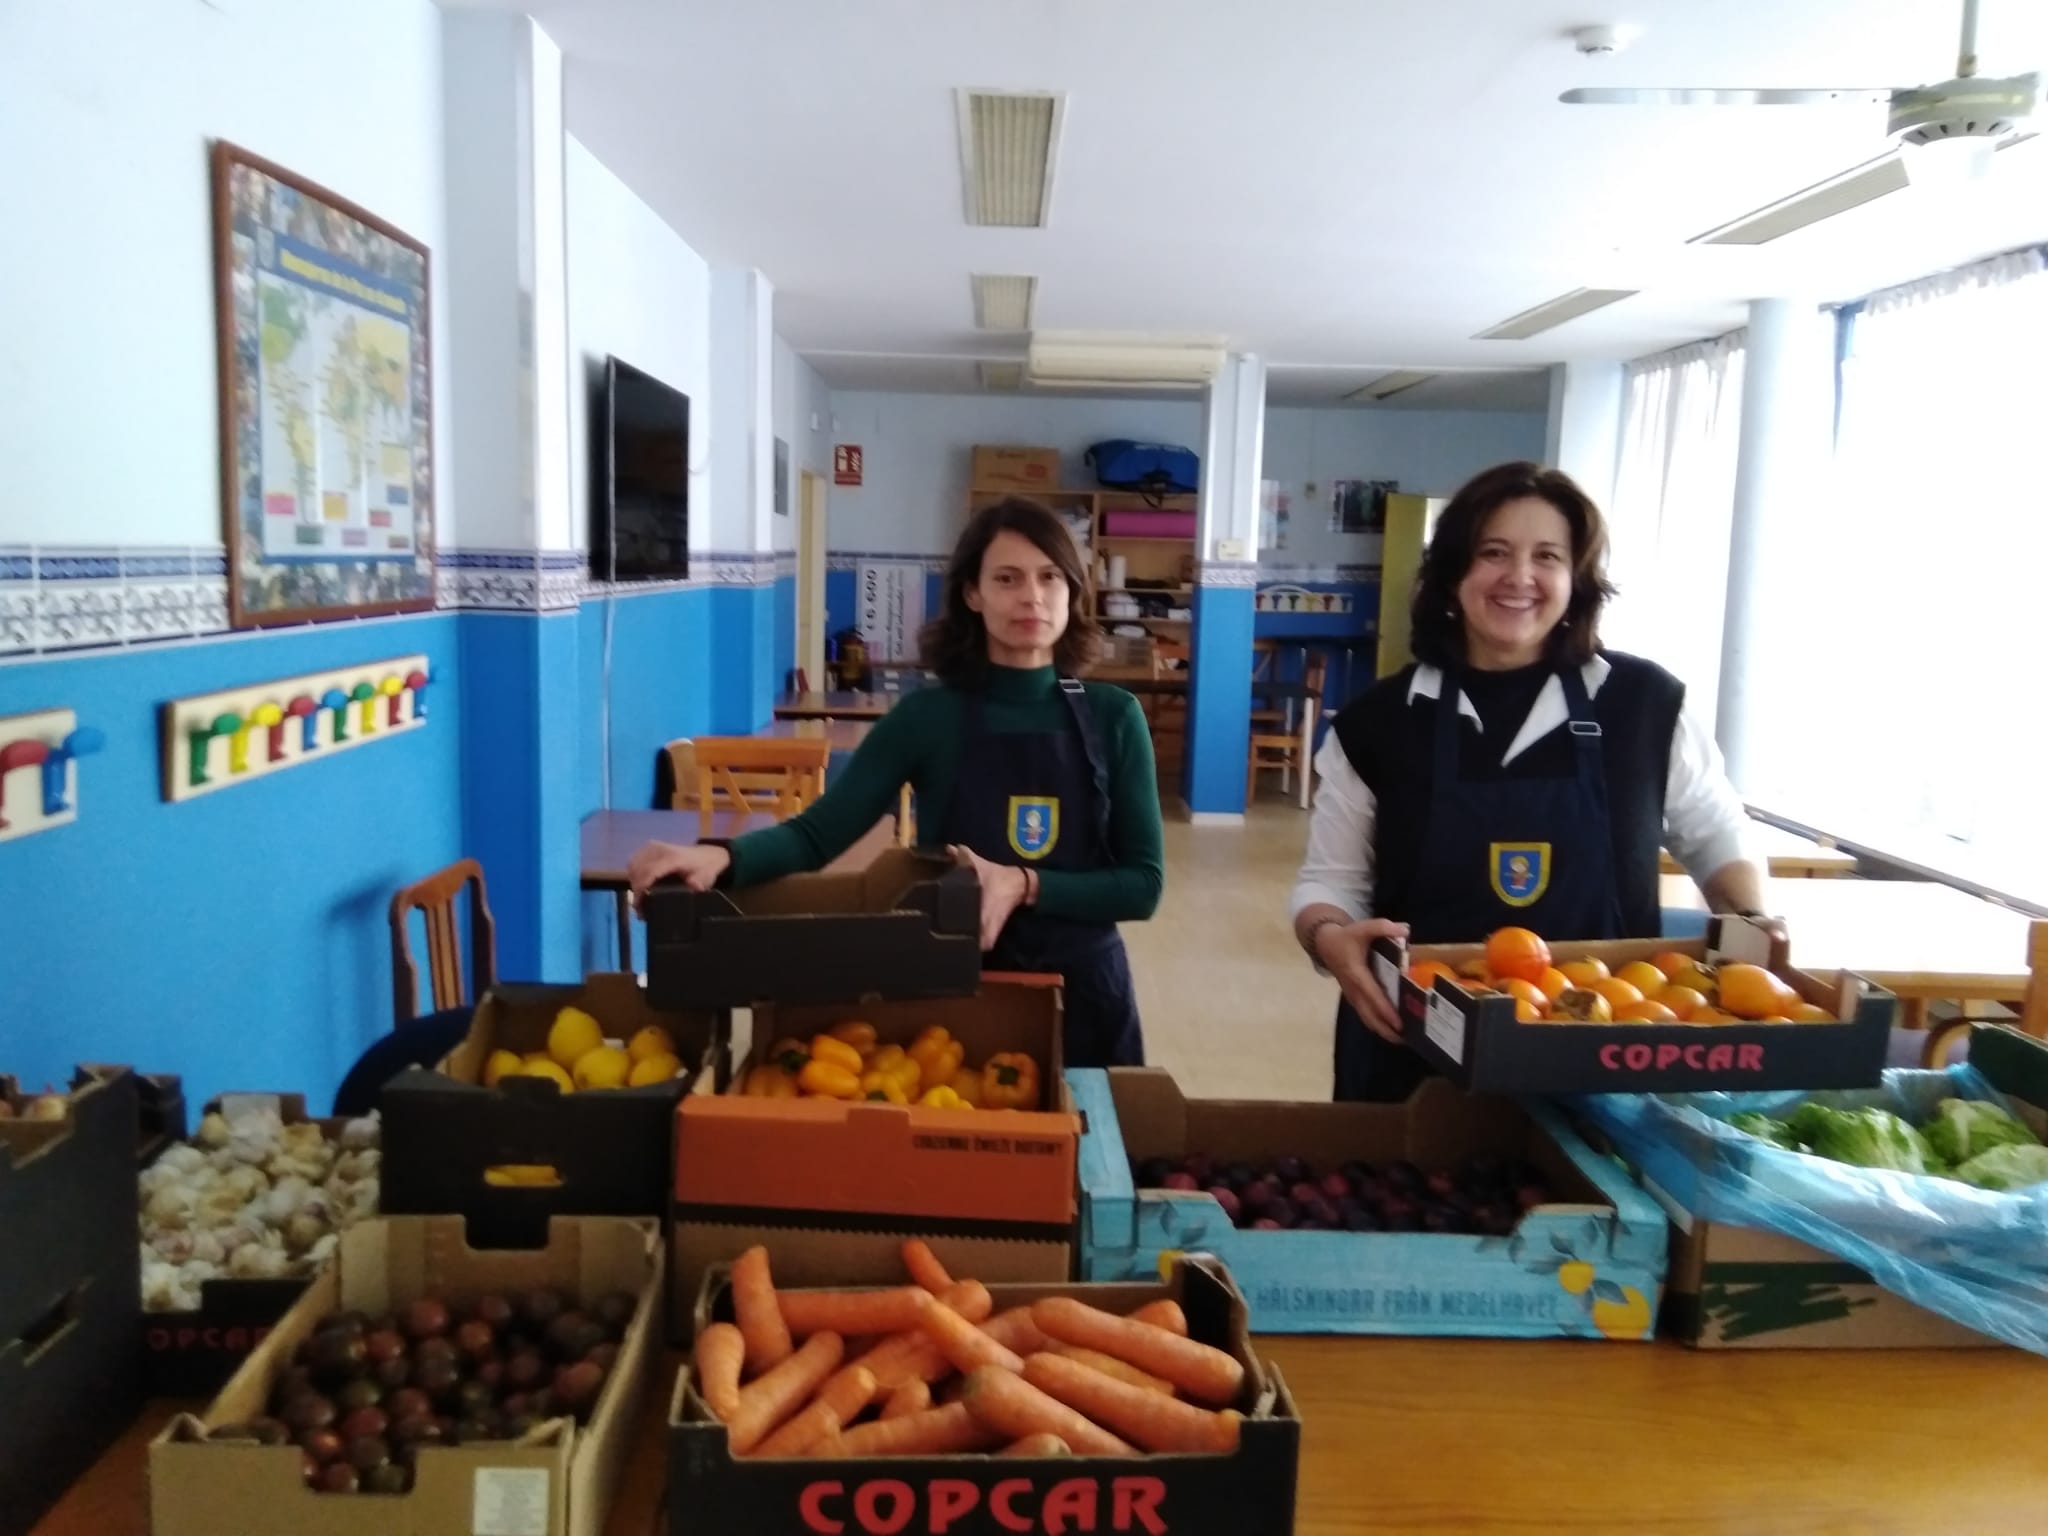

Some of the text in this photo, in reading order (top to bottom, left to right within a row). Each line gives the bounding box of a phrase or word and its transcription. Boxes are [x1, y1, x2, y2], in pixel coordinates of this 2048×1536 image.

[1599, 1043, 1765, 1071] COPCAR
[1383, 1284, 1433, 1315] FRÅN
[799, 1475, 1168, 1536] COPCAR
